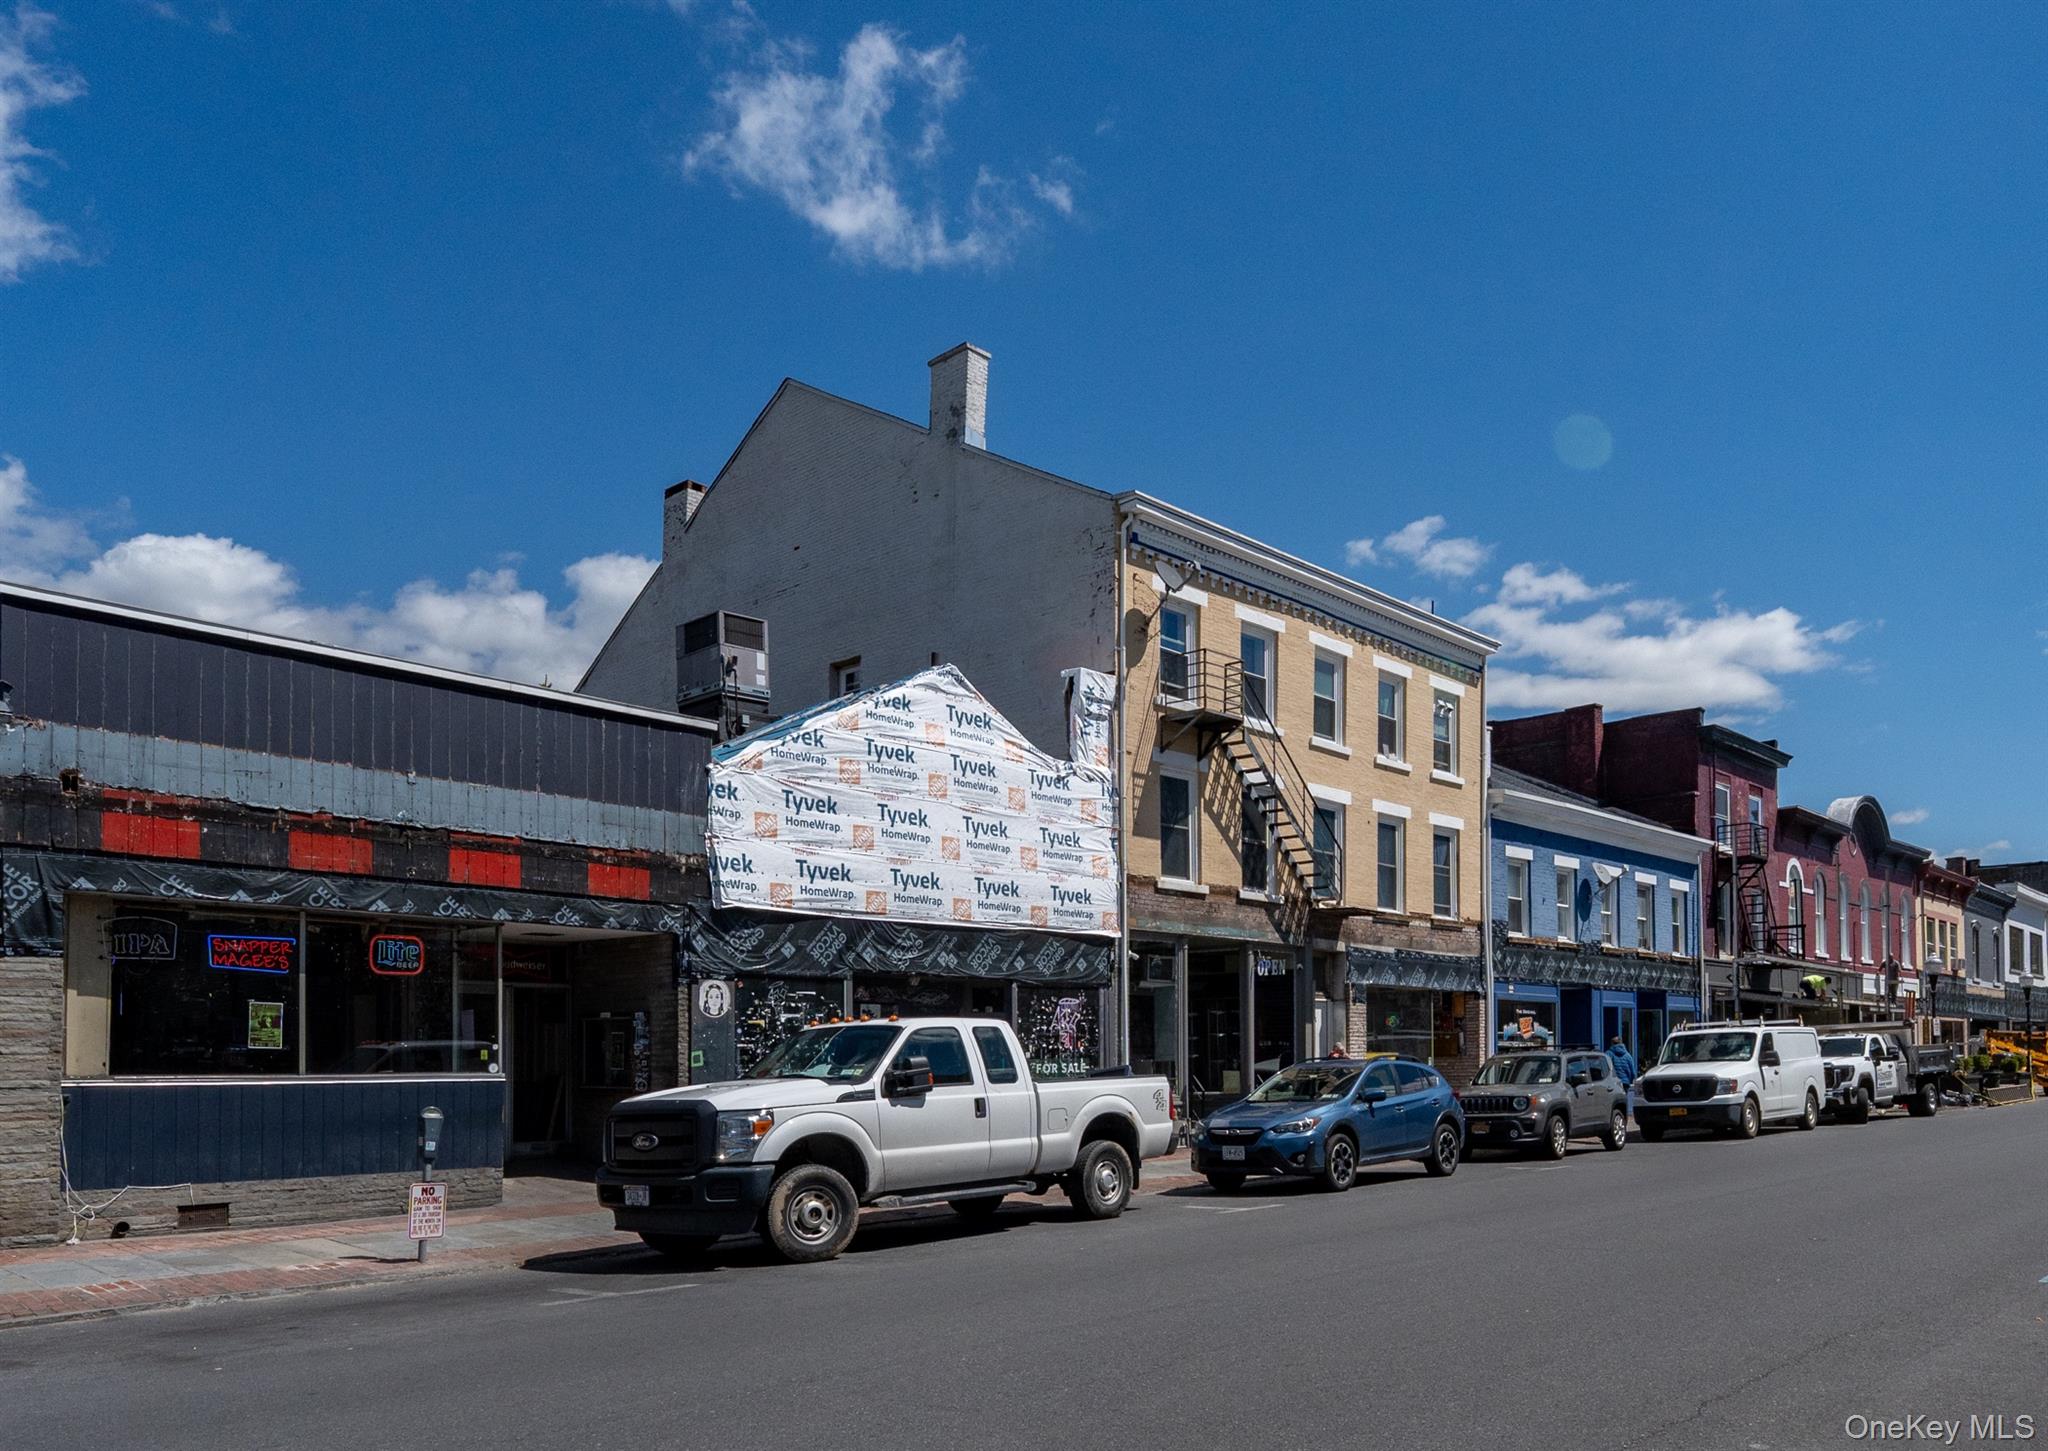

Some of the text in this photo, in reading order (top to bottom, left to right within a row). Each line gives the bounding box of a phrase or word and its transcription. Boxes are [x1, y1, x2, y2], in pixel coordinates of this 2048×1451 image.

[865, 709, 915, 729] HomeWrap
[946, 704, 992, 731] Tyvek
[950, 728, 995, 747] HomeWrap
[770, 747, 827, 767] HomeWrap
[864, 738, 916, 764] Tyvek
[950, 754, 997, 779] Tyvek
[954, 778, 999, 794] HomeWrap
[1028, 768, 1071, 791] Tyvek
[782, 788, 838, 815] Tyvek
[1031, 791, 1073, 807] HomeWrap
[785, 815, 841, 833] HomeWrap
[877, 803, 928, 828] Tyvek
[881, 827, 931, 845] HomeWrap
[962, 815, 1008, 839] Tyvek
[1040, 826, 1081, 849] Tyvek
[966, 838, 1011, 855] HomeWrap
[1042, 849, 1084, 864] HomeWrap
[795, 858, 851, 884] Tyvek
[890, 868, 941, 892] Tyvek
[800, 884, 855, 900] HomeWrap
[974, 876, 1020, 899] Tyvek
[1050, 884, 1092, 907] Tyvek
[893, 892, 943, 908] HomeWrap
[977, 900, 1022, 915] HomeWrap
[1053, 907, 1094, 920] HomeWrap
[114, 933, 170, 954] IPA
[212, 938, 293, 954] SNAPPER
[377, 940, 420, 965] Lite
[810, 924, 842, 960] VYCOR
[817, 932, 848, 968] GRACE
[213, 953, 289, 969] MAGEE'S
[969, 937, 997, 969] VYCOR
[975, 943, 1002, 977] GRACE
[1035, 940, 1061, 971] VYCOR
[1041, 945, 1066, 977] GRACE
[1257, 959, 1286, 977] OPEN
[1036, 1062, 1087, 1074] FOR SALE
[413, 1196, 442, 1205] PARKING
[421, 1187, 435, 1196] NO
